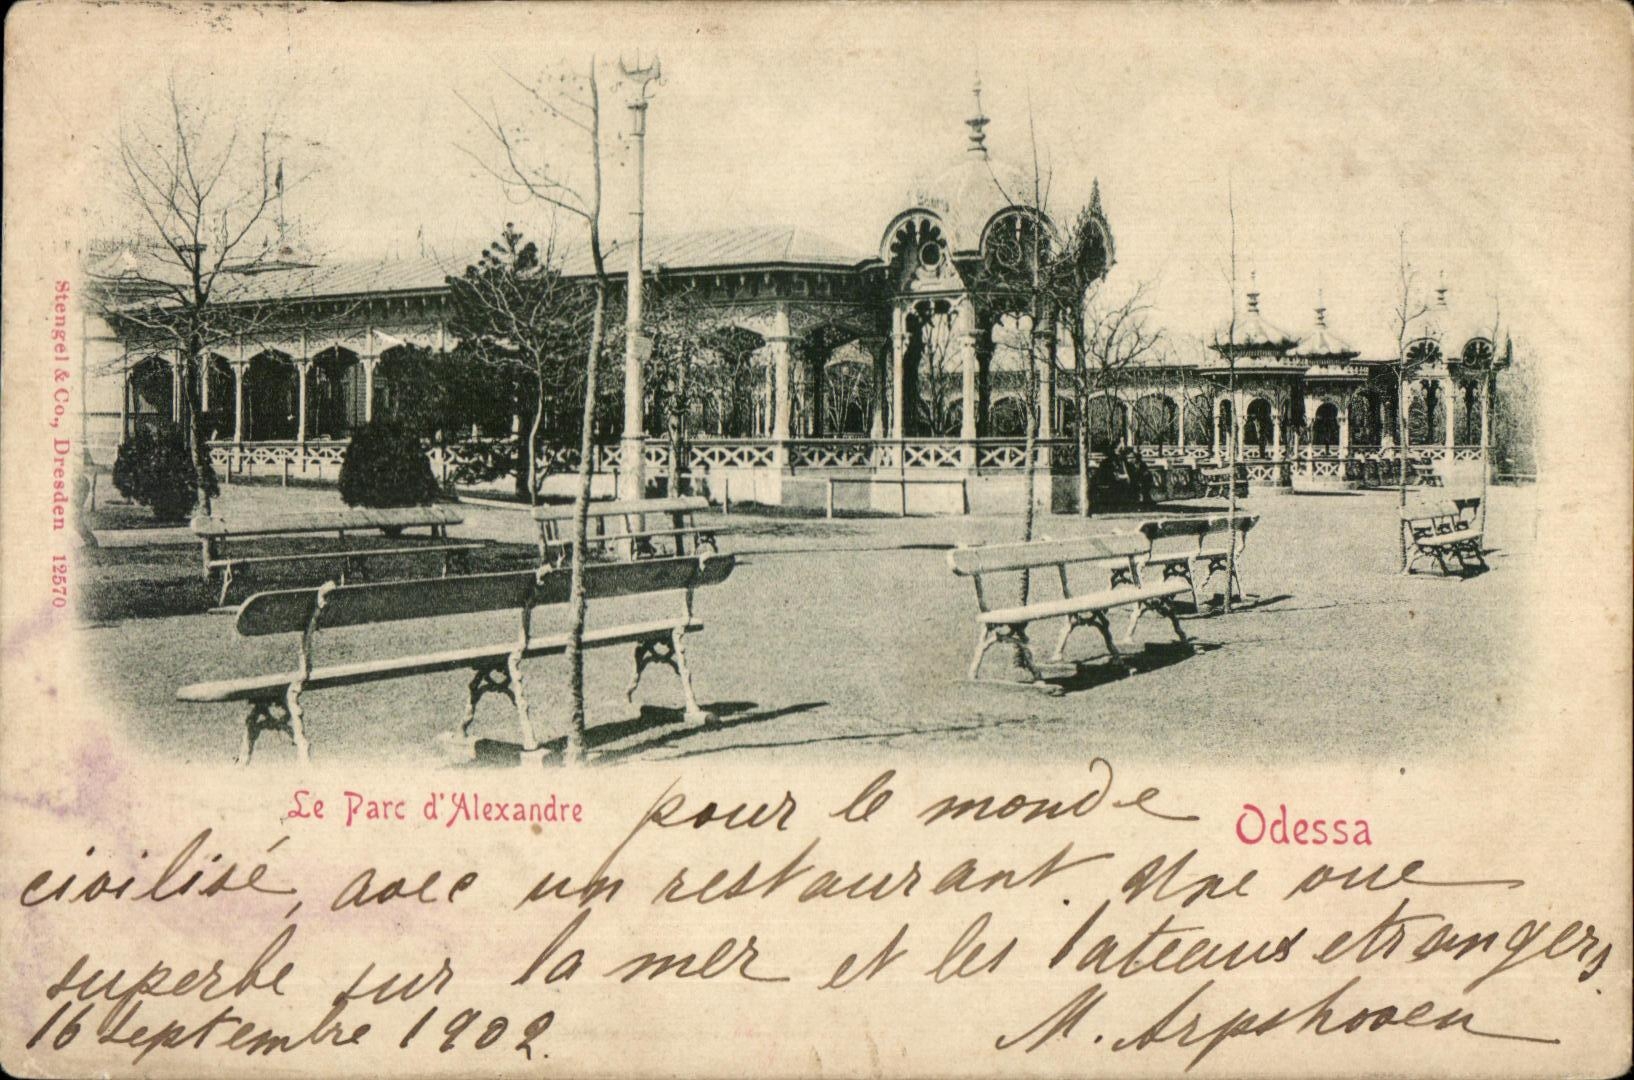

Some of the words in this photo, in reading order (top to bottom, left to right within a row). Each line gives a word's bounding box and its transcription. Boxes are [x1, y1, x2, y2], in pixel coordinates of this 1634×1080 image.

[580, 777, 797, 905] pour
[829, 769, 897, 822] le
[917, 757, 1200, 826] monde
[331, 867, 478, 912] avec
[514, 871, 625, 912] un
[1121, 848, 1258, 908] Une
[46, 923, 298, 1035] superbe
[332, 957, 454, 1007] sur
[510, 907, 592, 986] la
[602, 935, 790, 984] mer
[818, 924, 908, 990] et
[924, 911, 1018, 984] les
[26, 1001, 95, 1050] 16
